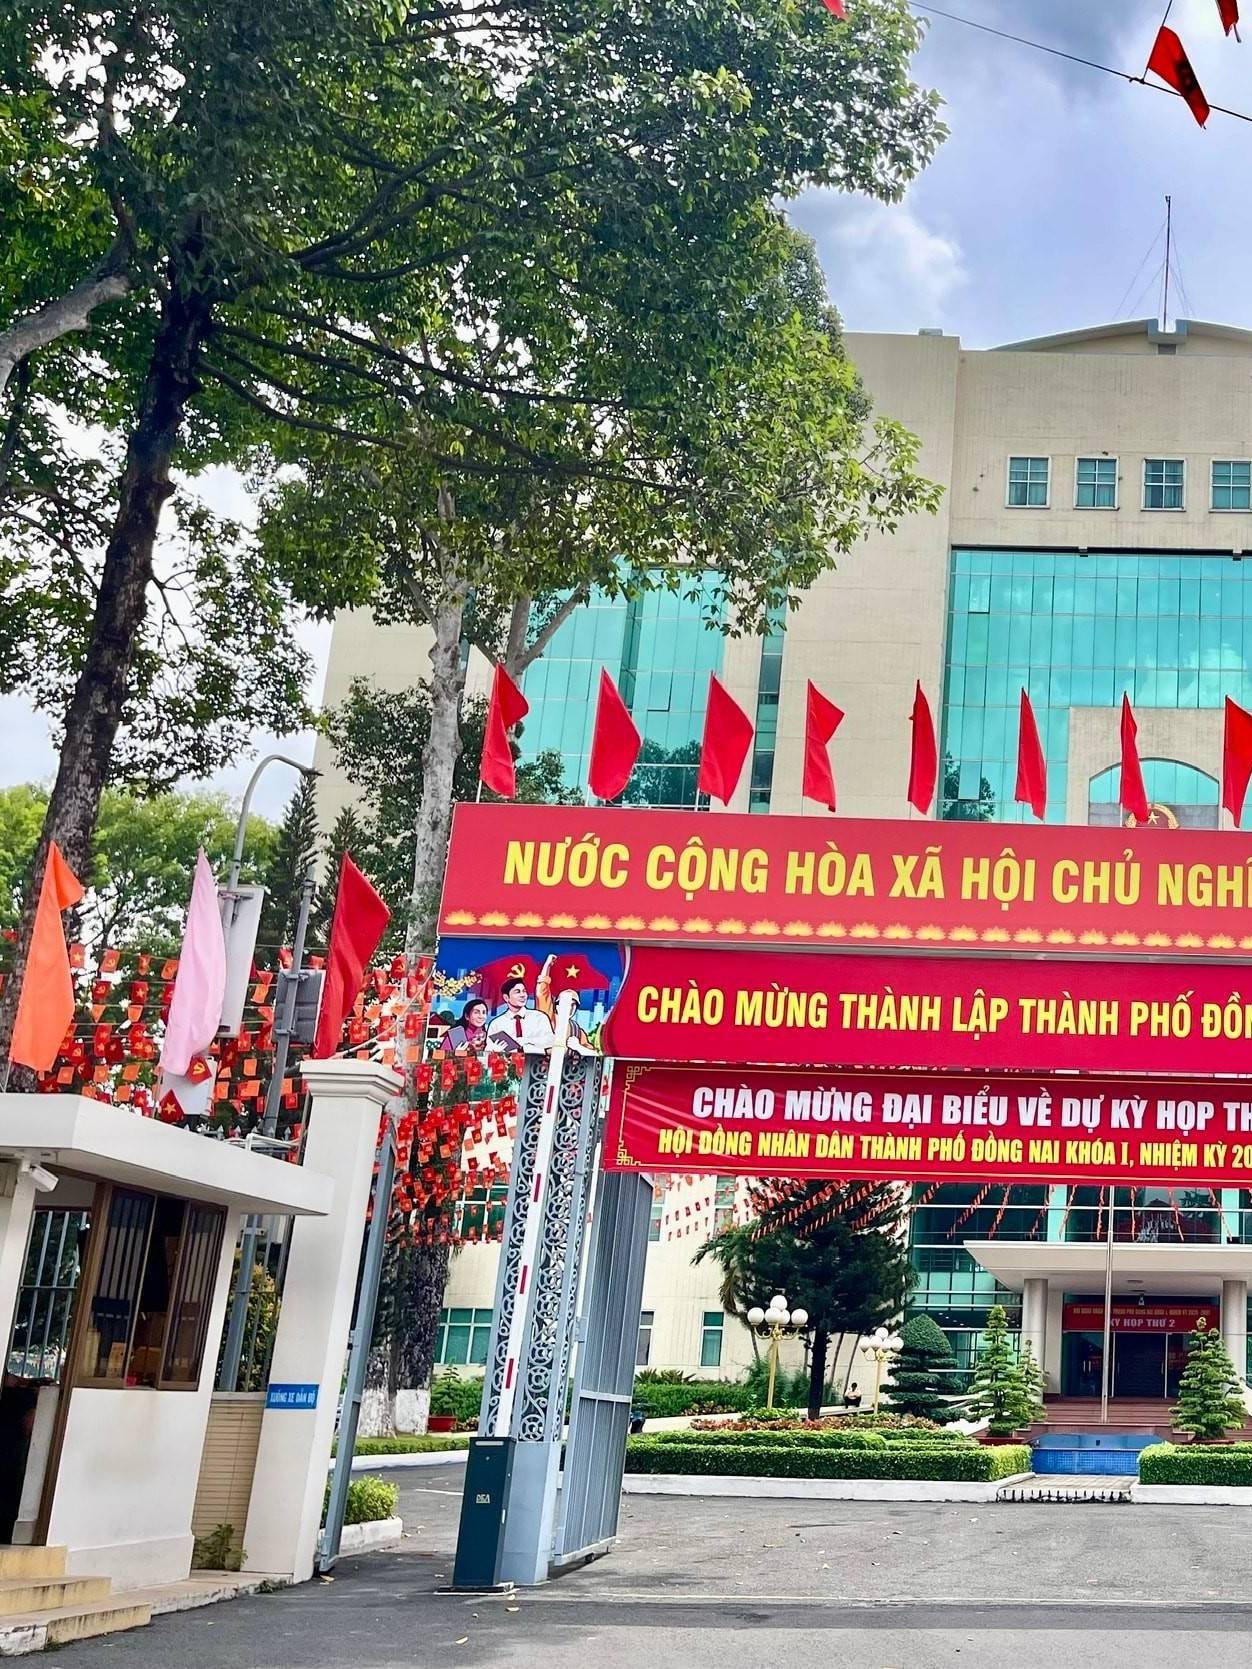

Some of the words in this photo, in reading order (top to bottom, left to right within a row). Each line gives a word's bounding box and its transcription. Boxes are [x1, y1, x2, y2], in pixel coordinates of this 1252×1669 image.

[504, 833, 629, 888] NƯỚC
[646, 836, 768, 901] CỘNG
[785, 841, 874, 896] HÒA
[889, 846, 945, 899] XÃ
[961, 848, 1035, 911] HỘI
[1052, 849, 1140, 905] CHỦ
[638, 980, 723, 1025] CHÀO
[735, 983, 827, 1028] MỪNG
[839, 987, 941, 1031] THÀNH
[953, 989, 1008, 1040] LẬP
[1019, 991, 1118, 1035] THÀNH
[1131, 991, 1194, 1037] PHỐ
[693, 1087, 775, 1119] CHÀO
[784, 1087, 872, 1122] MỪNG
[882, 1093, 932, 1129] ĐẠI
[942, 1085, 1008, 1125] BIỂU
[1018, 1087, 1053, 1127] VỀ
[1062, 1095, 1104, 1133] DỰ
[1111, 1095, 1147, 1128] KỲ
[1157, 1101, 1214, 1136] HỌP
[658, 1126, 692, 1159] HỘI
[698, 1124, 753, 1157] ĐỒNG
[758, 1129, 810, 1157] NHÂN
[815, 1130, 854, 1158] DÂN
[860, 1132, 922, 1160] THÀNH
[928, 1130, 965, 1161] PHỐ
[971, 1131, 1022, 1162] ĐỒNG
[1029, 1140, 1059, 1163] NAI
[1066, 1138, 1115, 1164] KHÓA
[1140, 1139, 1197, 1170] NHIỆM
[1204, 1141, 1227, 1167] KỲ
[1168, 1319, 1176, 1328] 2
